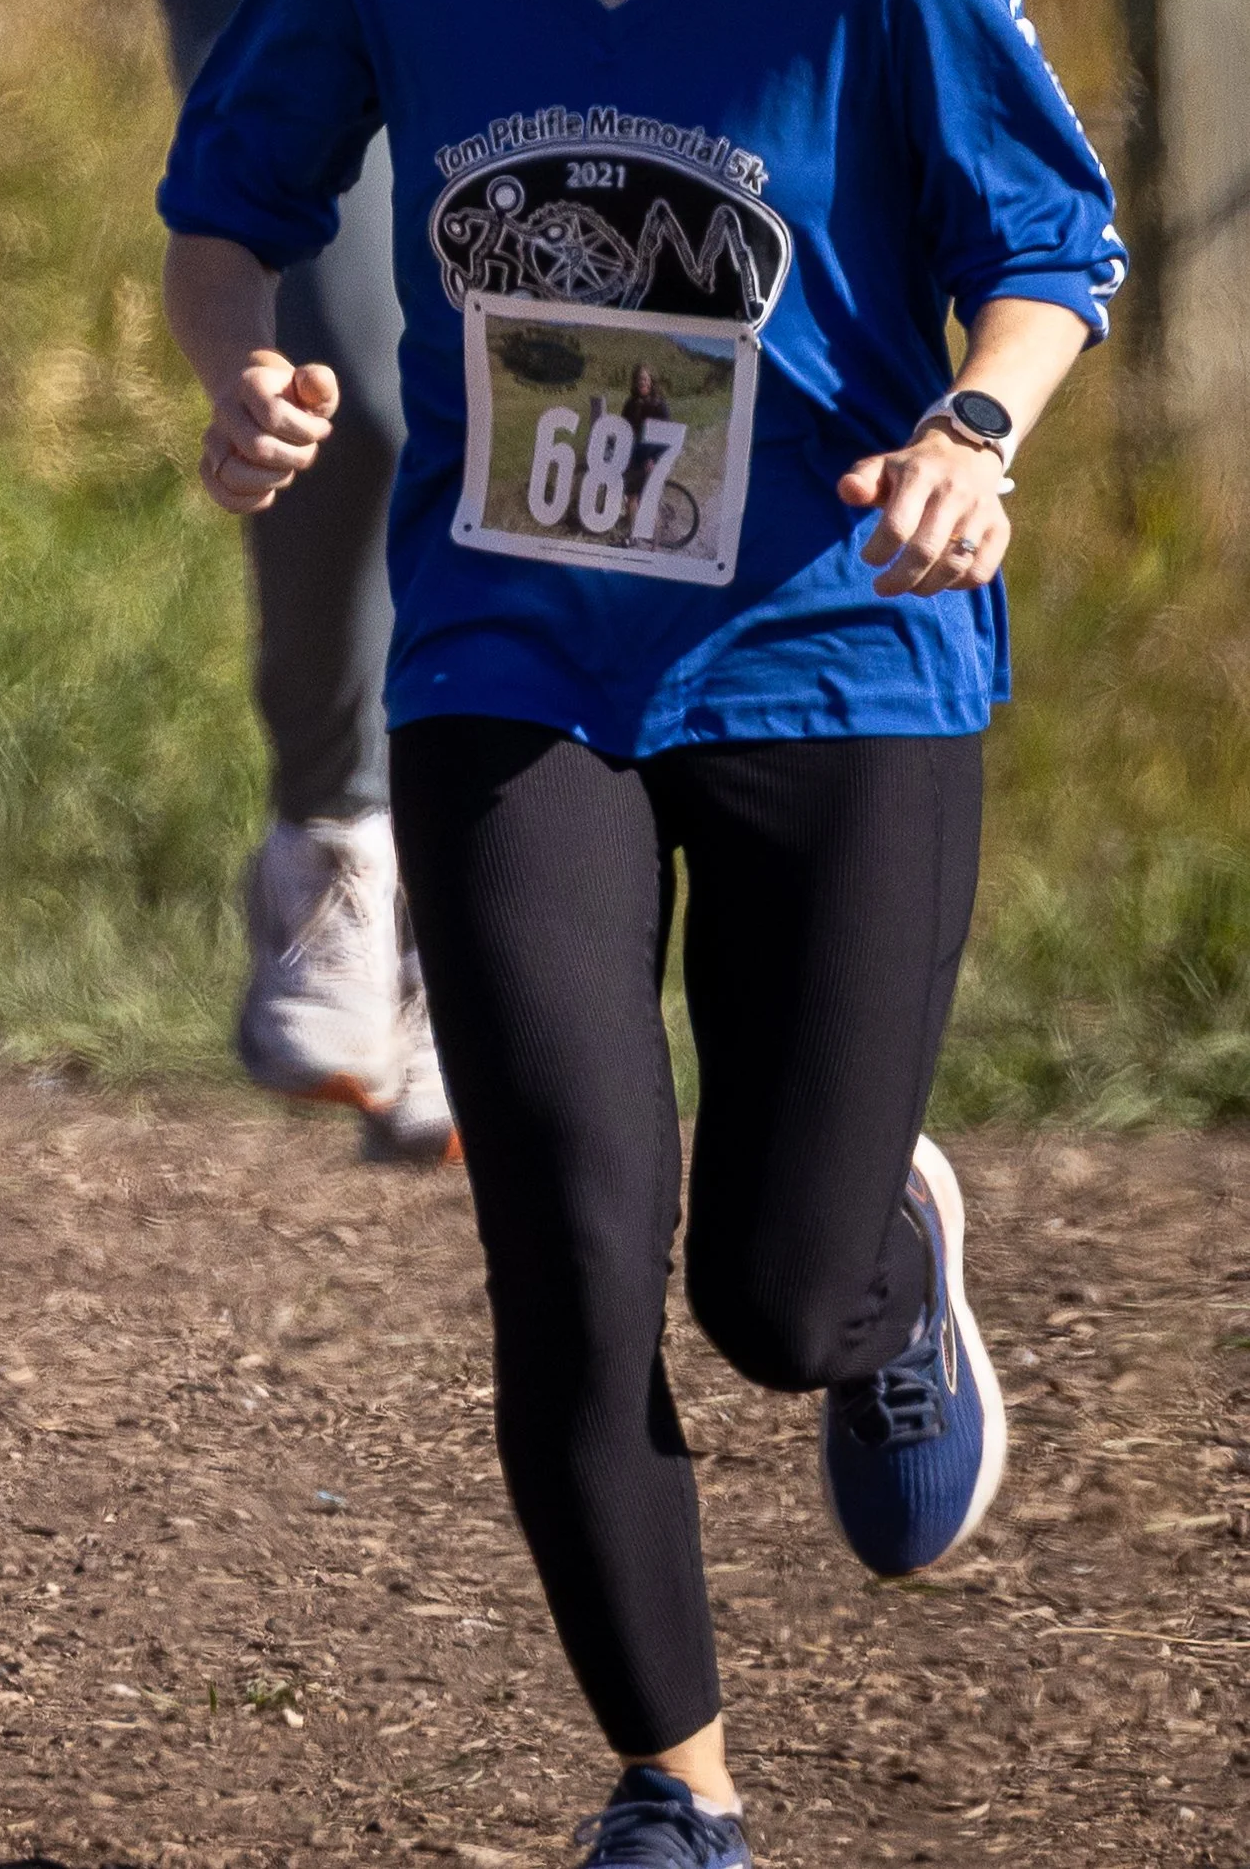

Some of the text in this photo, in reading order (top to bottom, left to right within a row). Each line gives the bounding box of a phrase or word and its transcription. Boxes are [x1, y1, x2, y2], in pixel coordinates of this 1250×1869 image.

[434, 104, 769, 196] Tom Pfeifle Memorial 5k
[566, 161, 627, 189] 2021
[528, 405, 687, 540] 687
